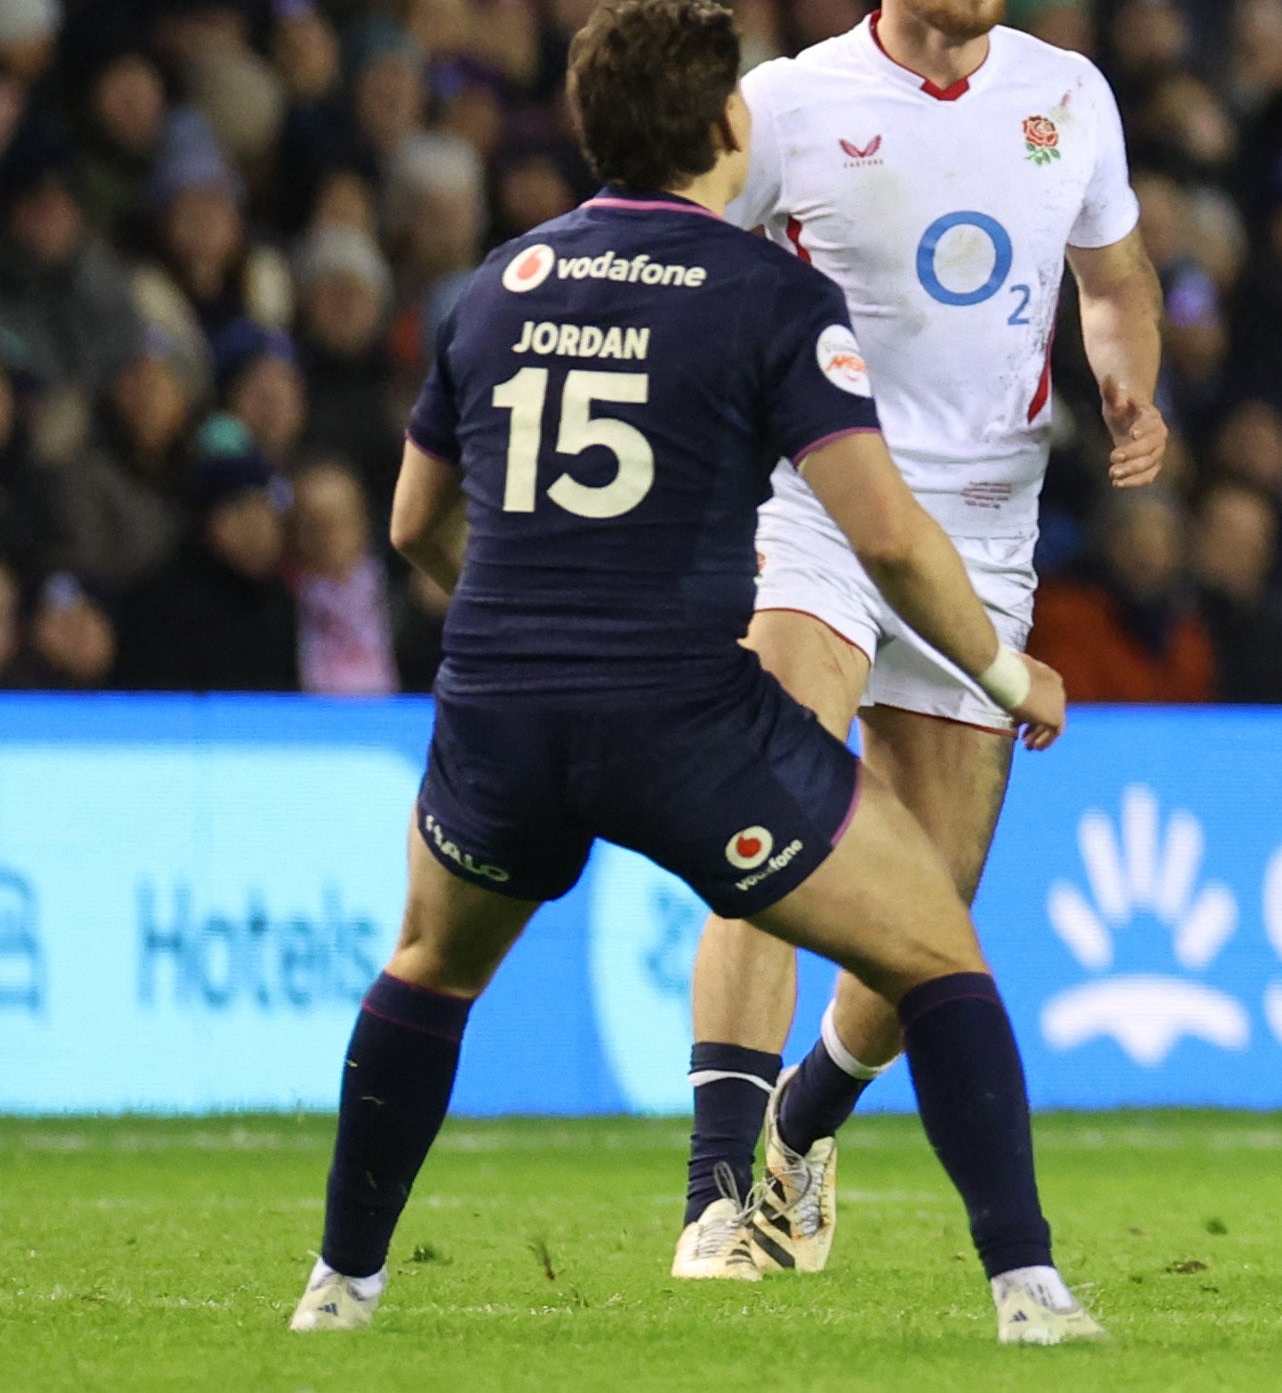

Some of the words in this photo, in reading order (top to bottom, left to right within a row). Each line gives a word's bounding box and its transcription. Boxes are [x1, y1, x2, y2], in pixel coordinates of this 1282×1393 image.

[556, 250, 708, 288] vodafone
[916, 210, 1031, 326] O2
[511, 321, 651, 360] JORDAN
[491, 366, 656, 520] 15
[137, 870, 380, 1010] Hotels
